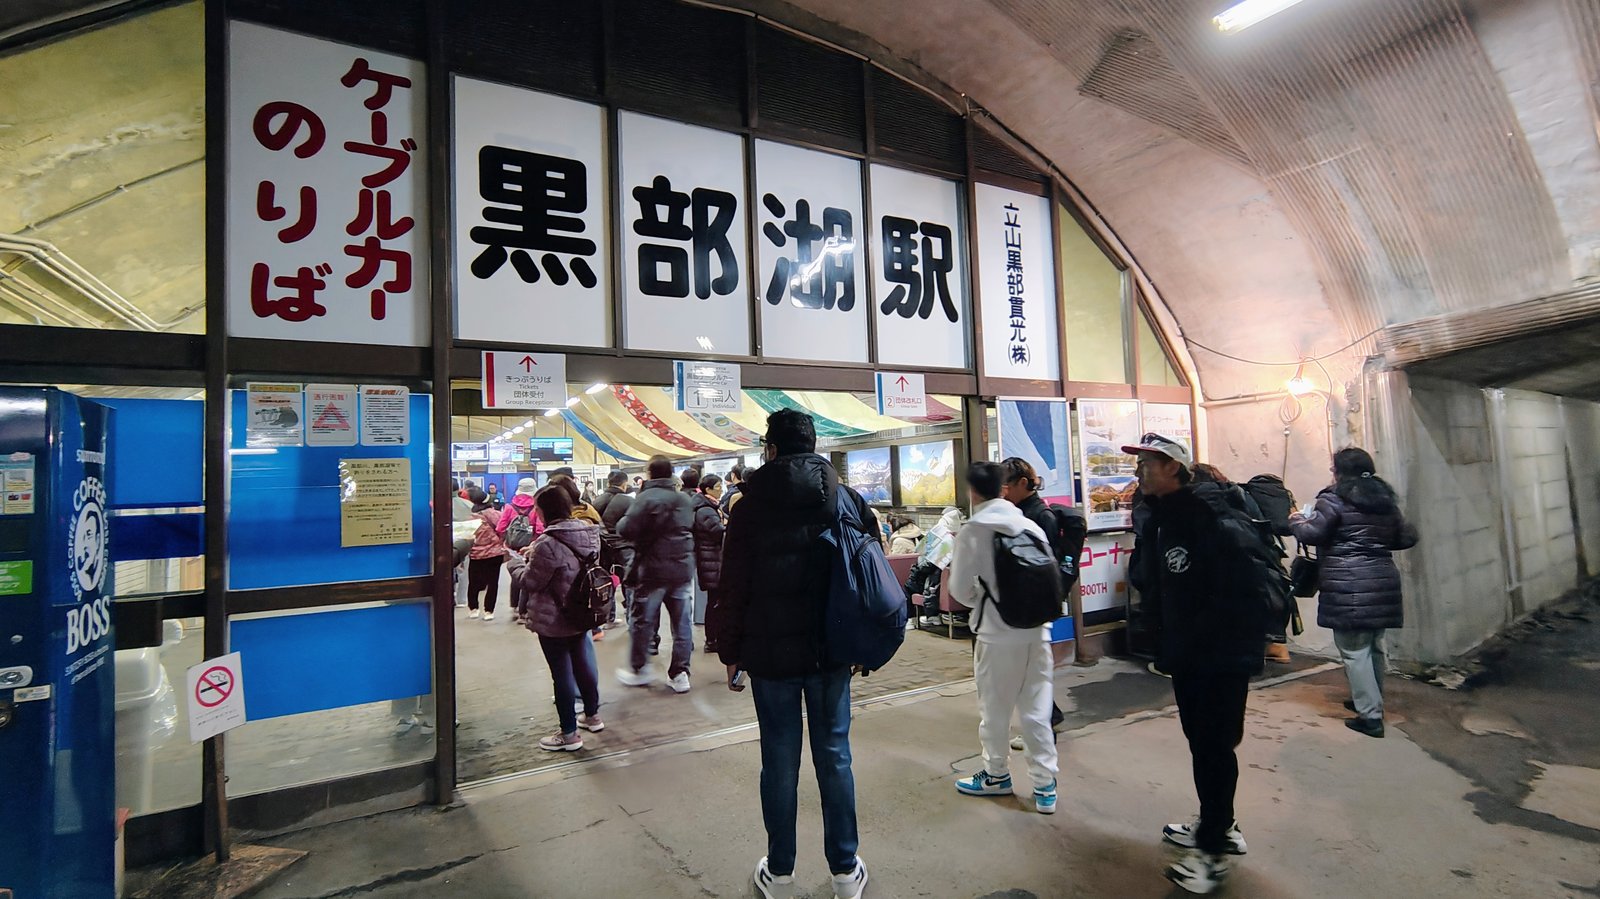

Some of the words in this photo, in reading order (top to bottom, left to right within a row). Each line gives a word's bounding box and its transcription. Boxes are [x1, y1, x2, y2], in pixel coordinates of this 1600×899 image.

[251, 101, 333, 321] のりば
[341, 58, 418, 320] ケーブルカー
[470, 145, 959, 323] 黒部湖駅
[505, 375, 552, 383] きっぷうりば
[887, 398, 893, 407] 2
[73, 476, 107, 511] COFFEE
[1080, 582, 1108, 596] BOOTH
[66, 595, 110, 655] BOSS
